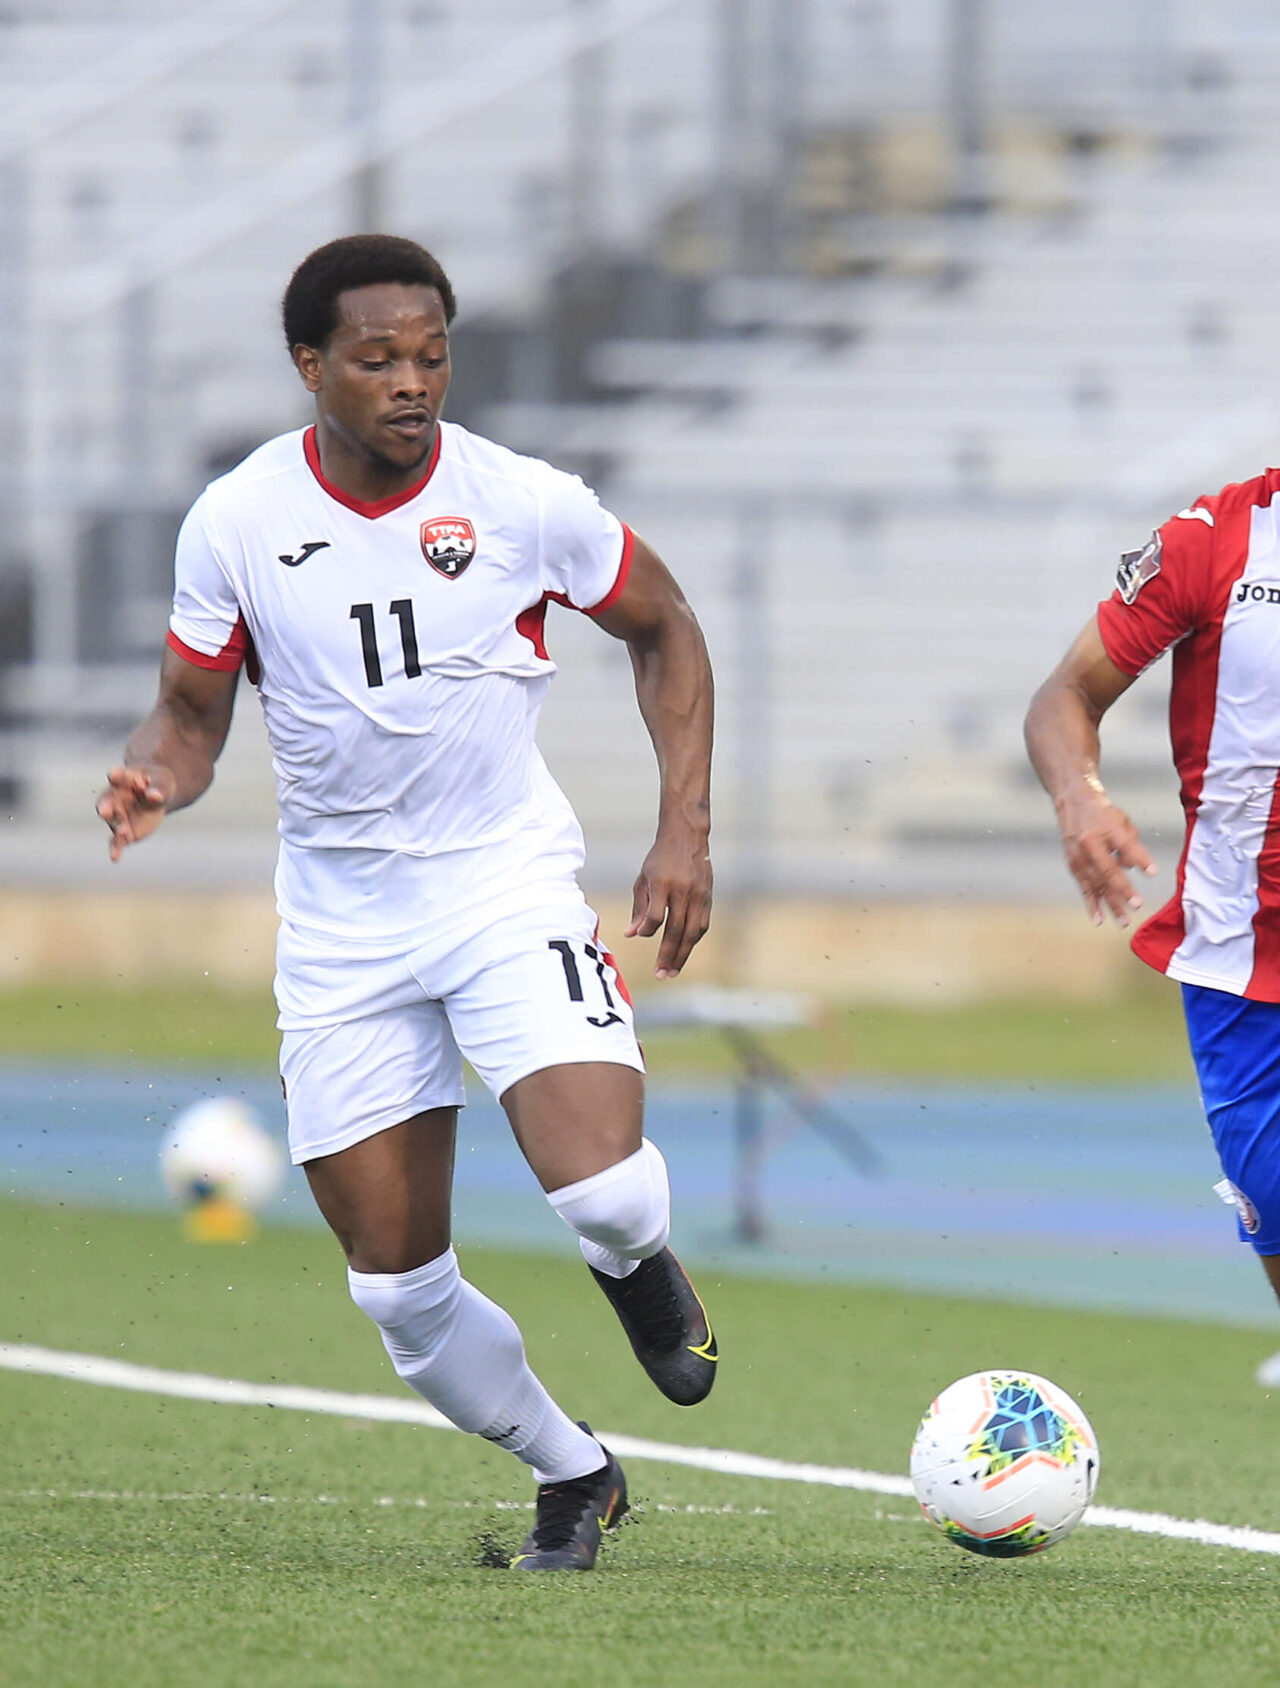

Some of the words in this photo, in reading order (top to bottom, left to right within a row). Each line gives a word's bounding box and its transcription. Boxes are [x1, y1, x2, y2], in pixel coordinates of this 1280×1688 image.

[428, 525, 466, 537] TTFA
[349, 598, 422, 688] 11
[548, 941, 615, 1009] 11
